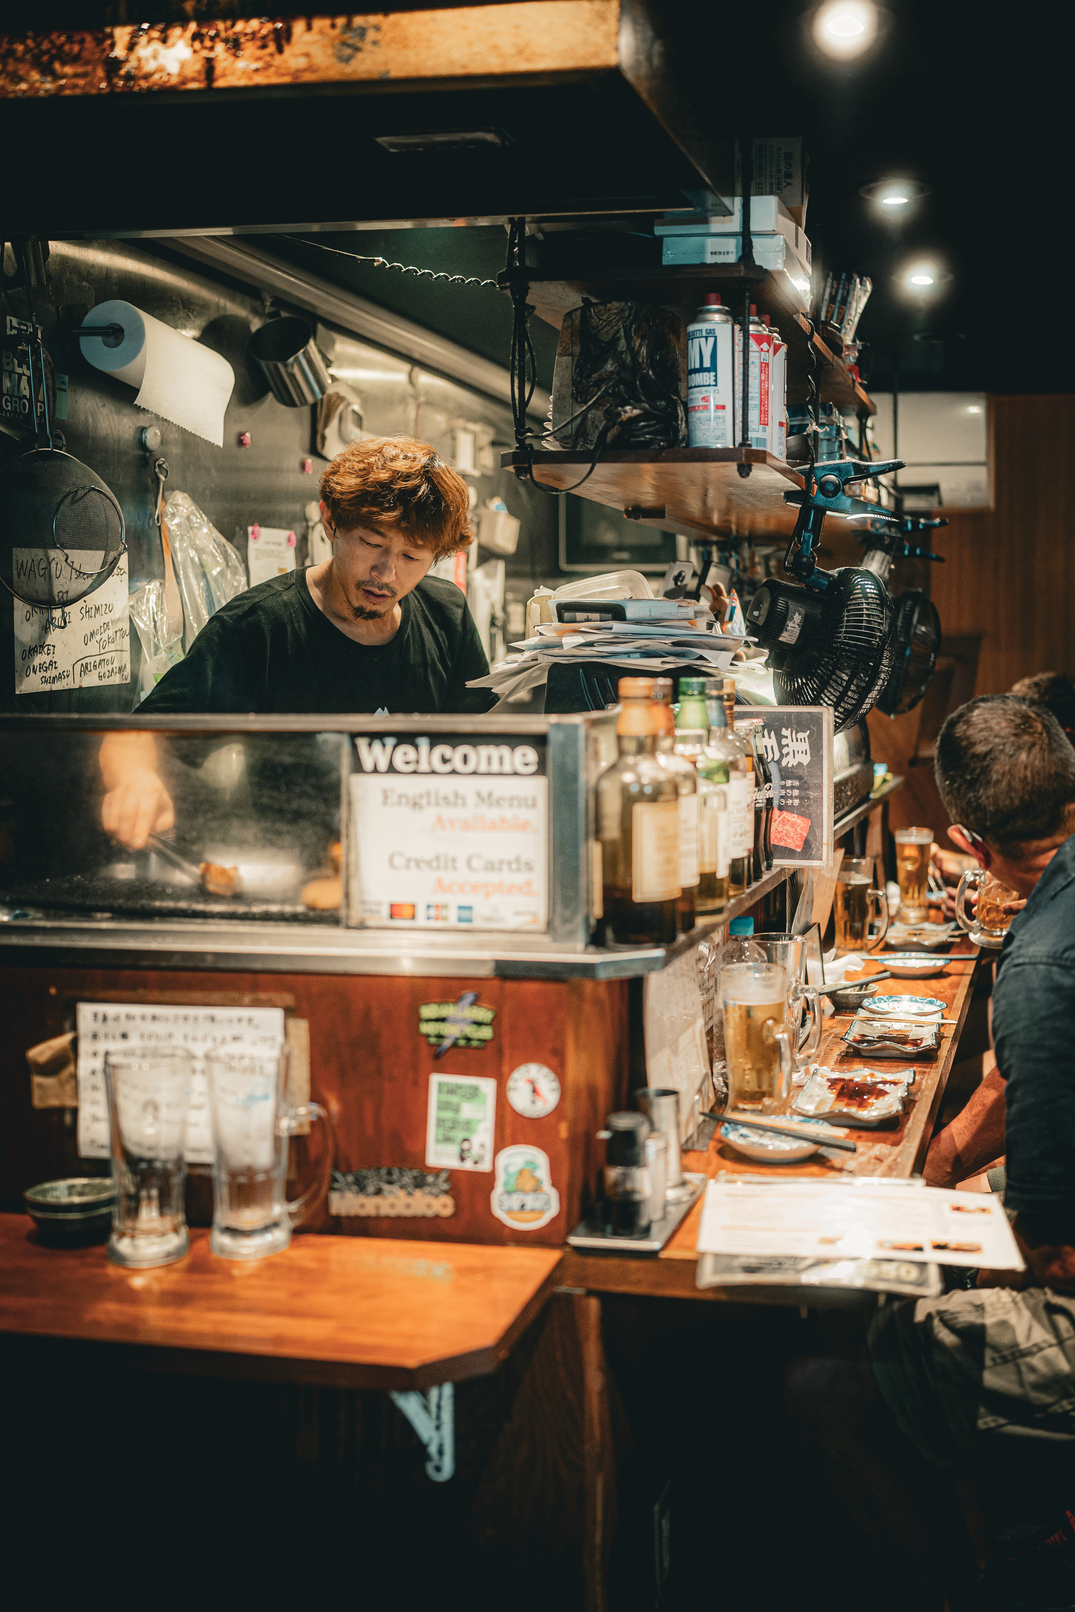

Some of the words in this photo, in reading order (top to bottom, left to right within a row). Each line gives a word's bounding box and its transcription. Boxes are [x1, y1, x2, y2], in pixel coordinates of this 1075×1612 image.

[687, 336, 715, 370] MY
[2, 395, 45, 417] GROP
[16, 557, 63, 581] WAGYU
[79, 603, 114, 621] SHIMIZU
[25, 660, 58, 678] ONEGAI
[79, 656, 115, 677] ARIGATOU
[354, 736, 539, 775] Welcome
[381, 788, 466, 811] English
[474, 790, 538, 809] Menu
[431, 814, 538, 833] Available.
[388, 851, 458, 871] Credit
[466, 853, 535, 873] Cards
[432, 877, 539, 898] Accepted.
